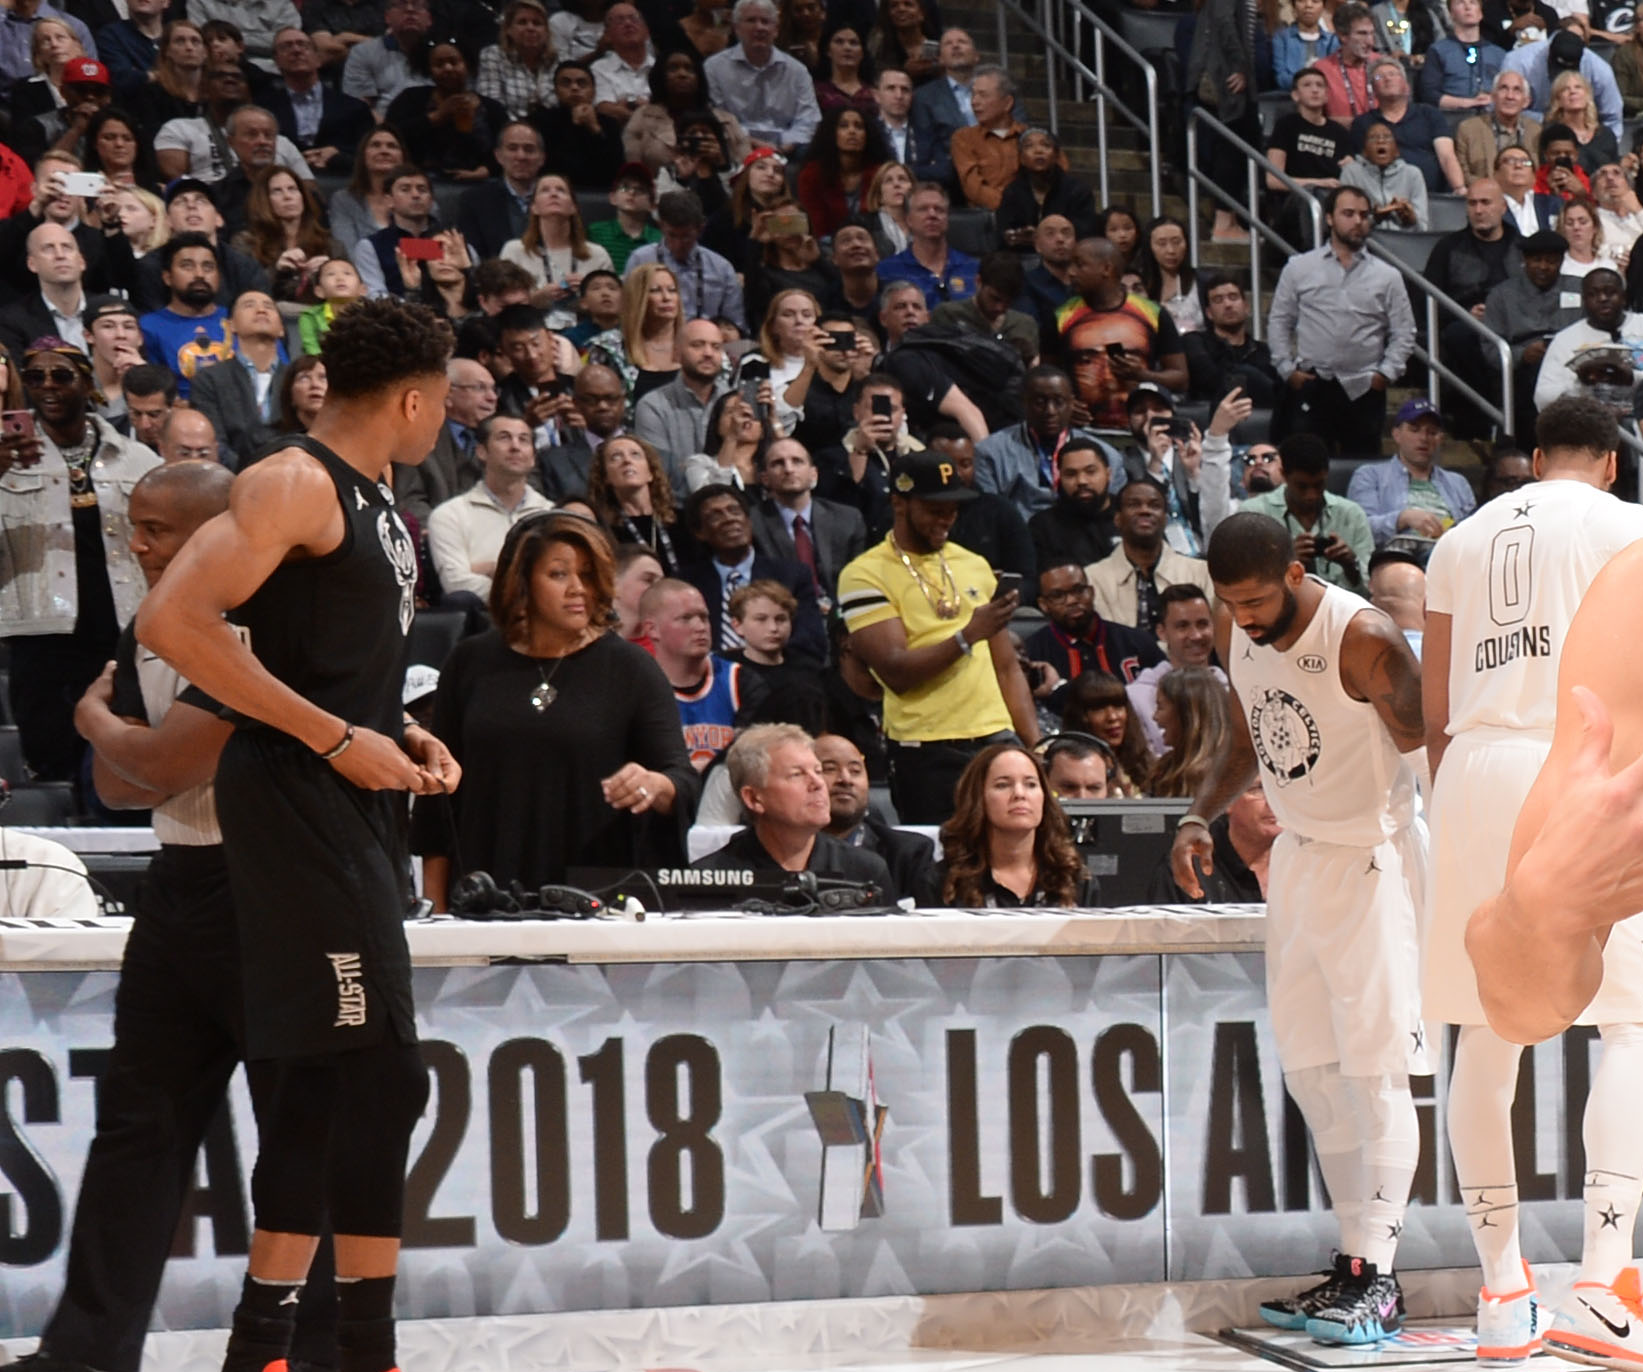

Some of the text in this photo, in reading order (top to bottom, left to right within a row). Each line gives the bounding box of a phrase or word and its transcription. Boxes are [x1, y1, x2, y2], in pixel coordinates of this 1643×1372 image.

[939, 463, 953, 485] P
[1489, 524, 1535, 626] 0
[658, 869, 754, 886] SAMSUNG
[326, 952, 366, 1028] ALL-STAR
[401, 1032, 726, 1250] 2018
[945, 1022, 1164, 1227] LOS
